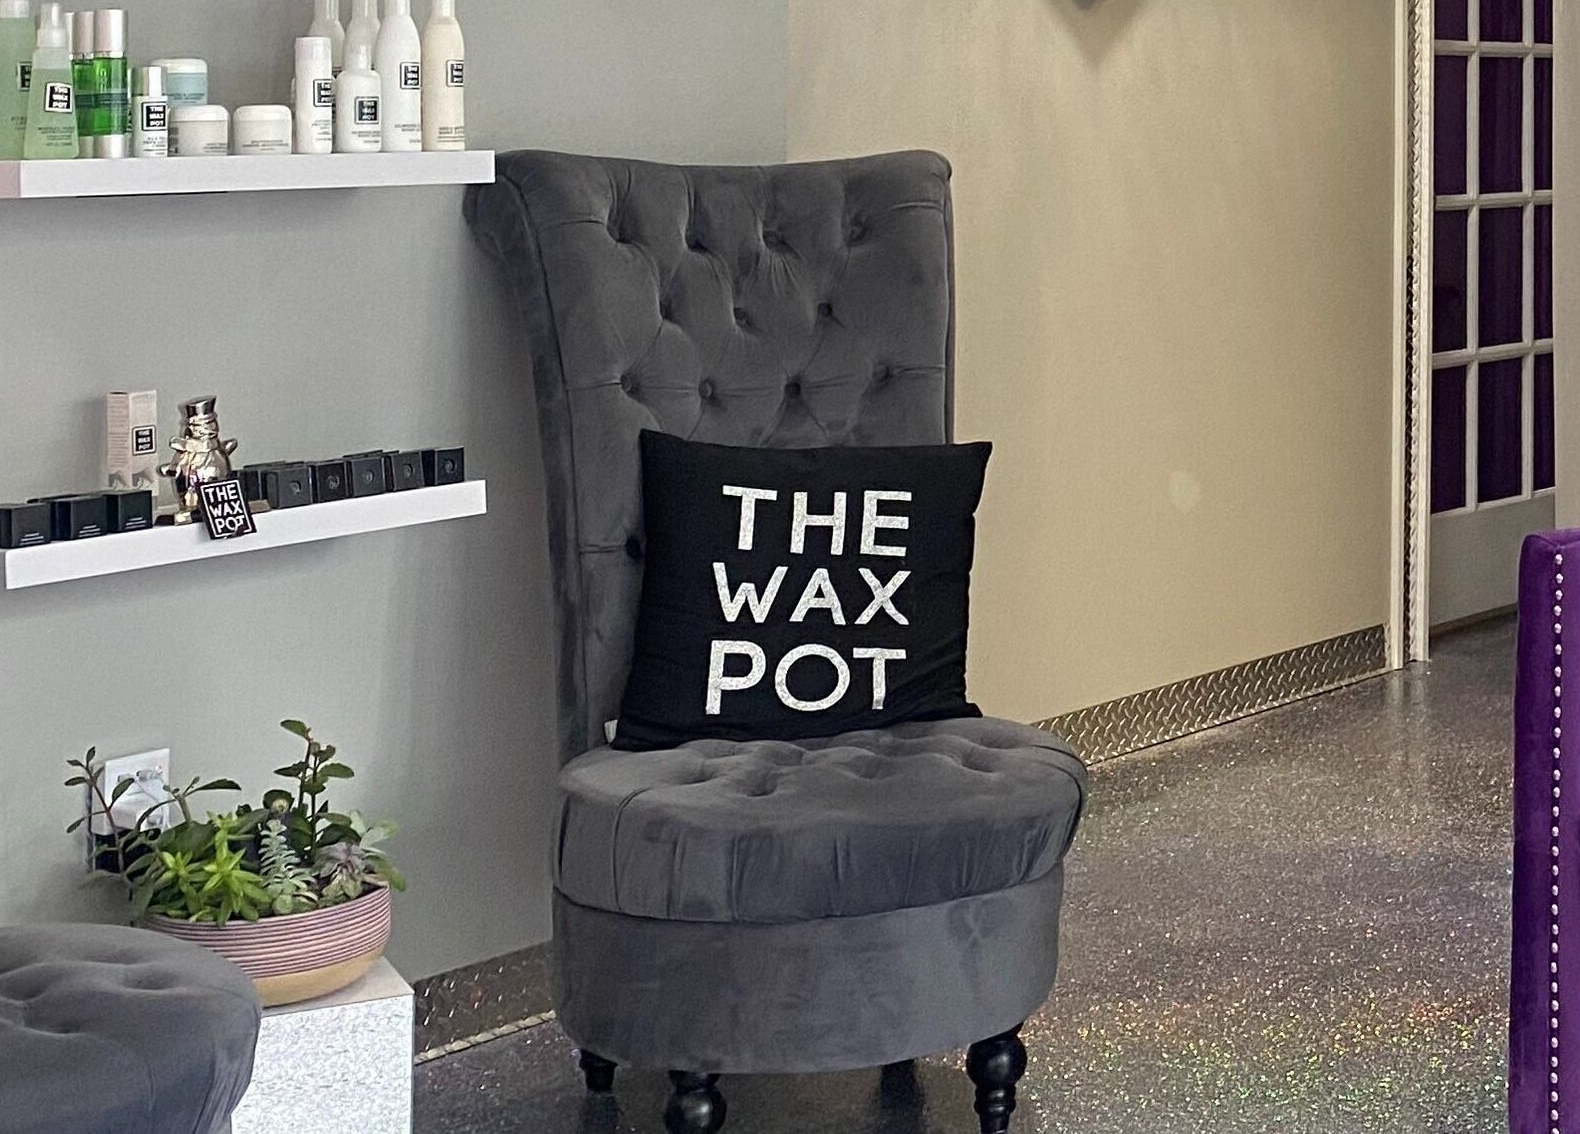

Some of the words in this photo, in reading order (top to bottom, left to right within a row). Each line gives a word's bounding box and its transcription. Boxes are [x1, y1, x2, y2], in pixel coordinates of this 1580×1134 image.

[205, 483, 238, 503] THE
[209, 500, 243, 518] WAX
[214, 514, 245, 534] POT
[722, 484, 912, 557] THE
[712, 561, 912, 626] WAX
[705, 639, 907, 715] POT
